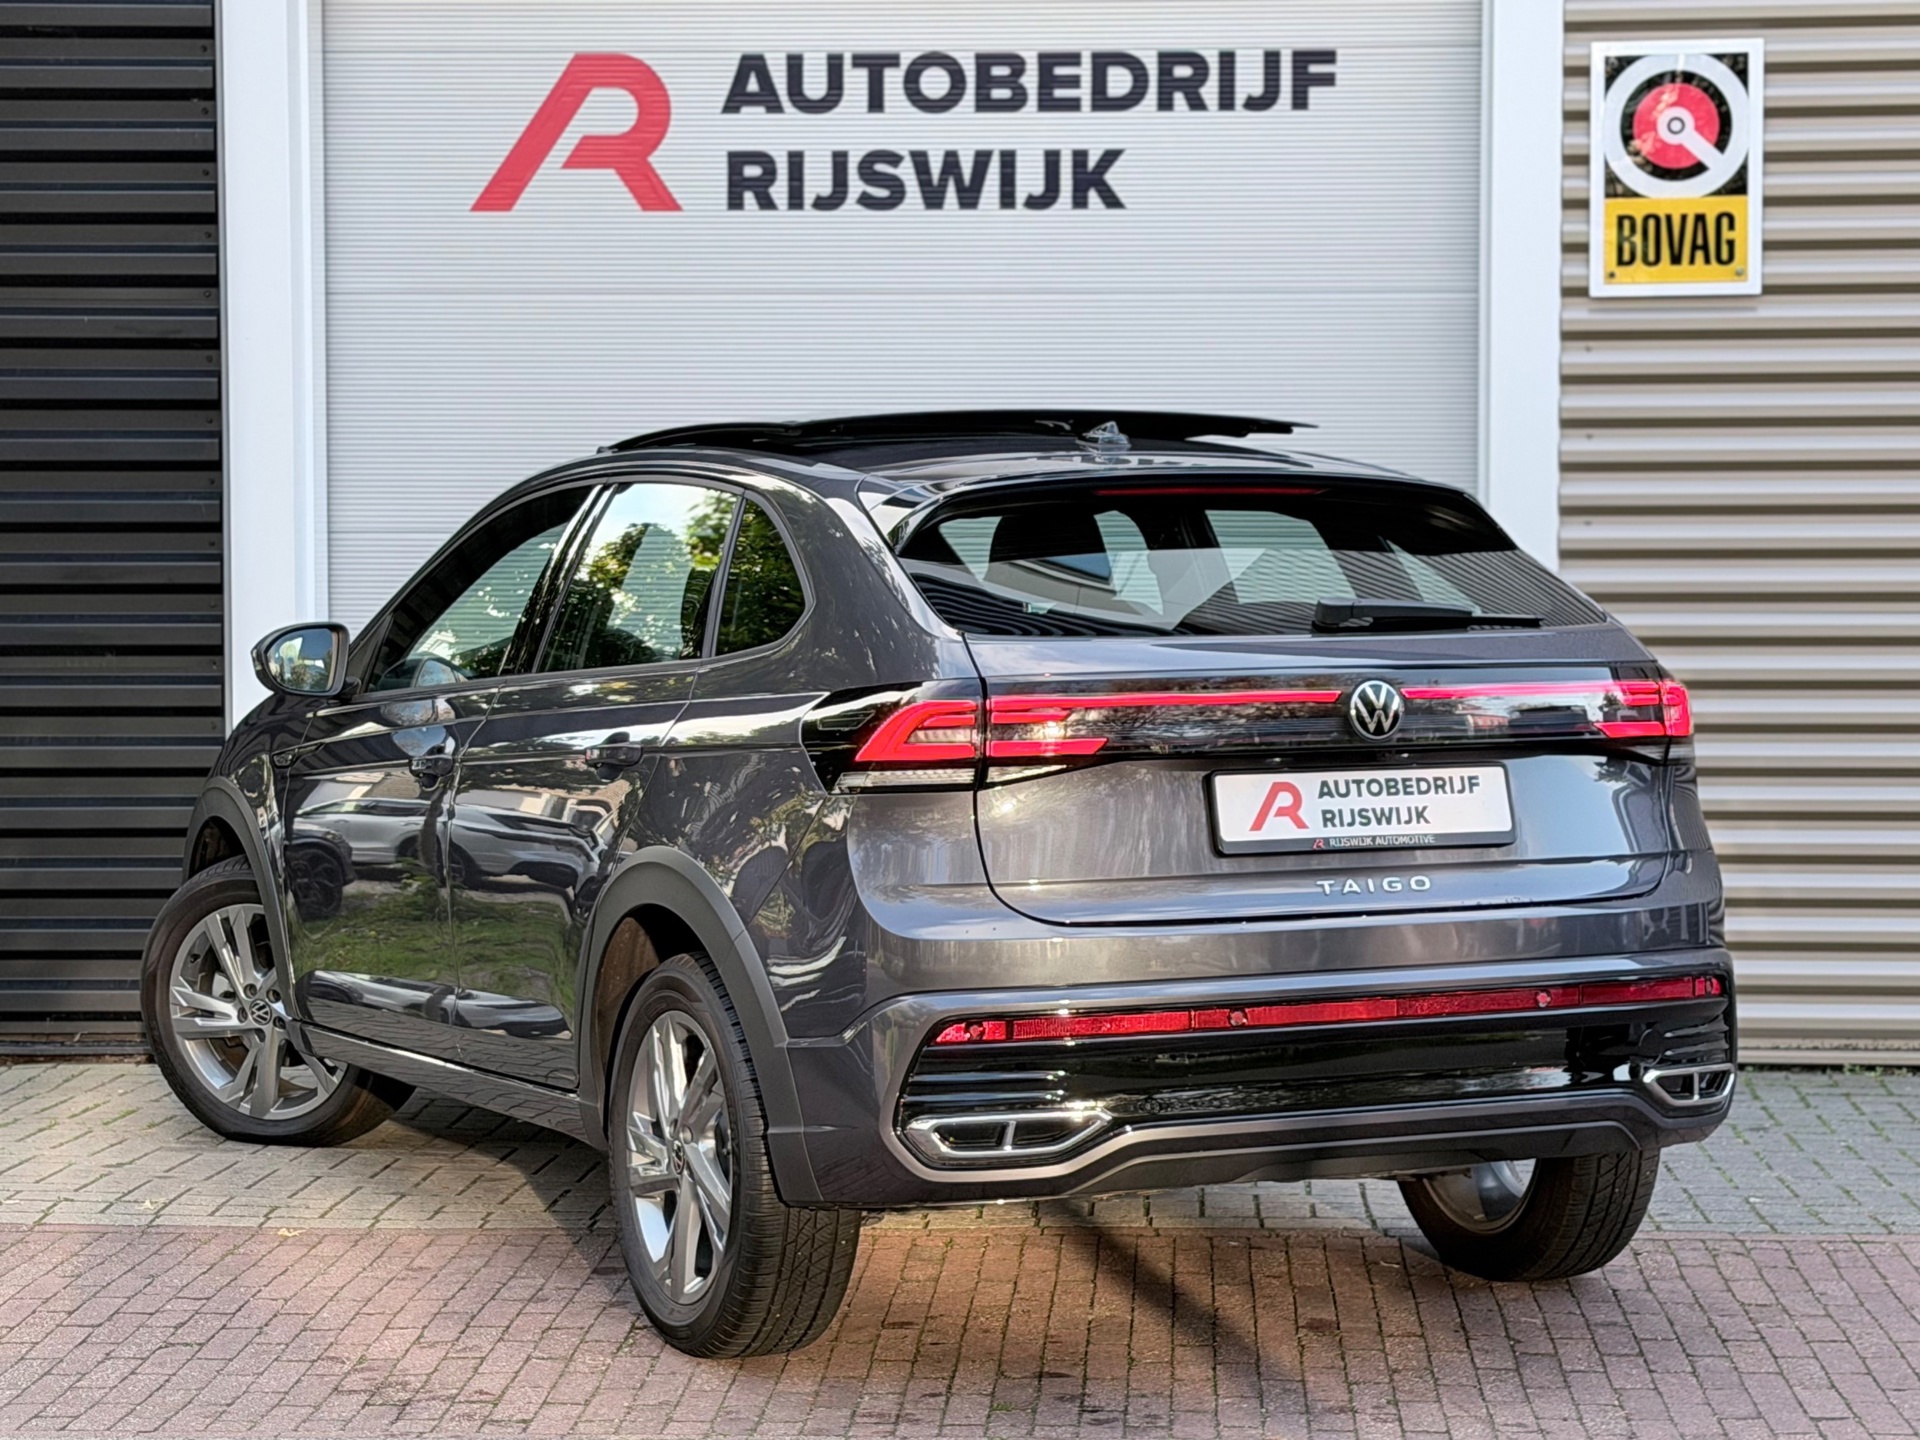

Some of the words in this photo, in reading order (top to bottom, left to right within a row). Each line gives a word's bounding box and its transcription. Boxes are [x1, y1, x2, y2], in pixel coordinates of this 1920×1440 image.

[721, 50, 1337, 114] AUTOBEDRIJF
[727, 149, 1126, 211] RIJSWIJK
[1616, 212, 1736, 267] BOVAG
[1317, 775, 1480, 799] AUTOBEDRIJF
[1321, 806, 1431, 828] RIJSWIJK
[1329, 837, 1373, 848] RIJSWIJK
[1375, 835, 1436, 846] AUTOMOTIVE
[1316, 875, 1431, 895] TAIGO
